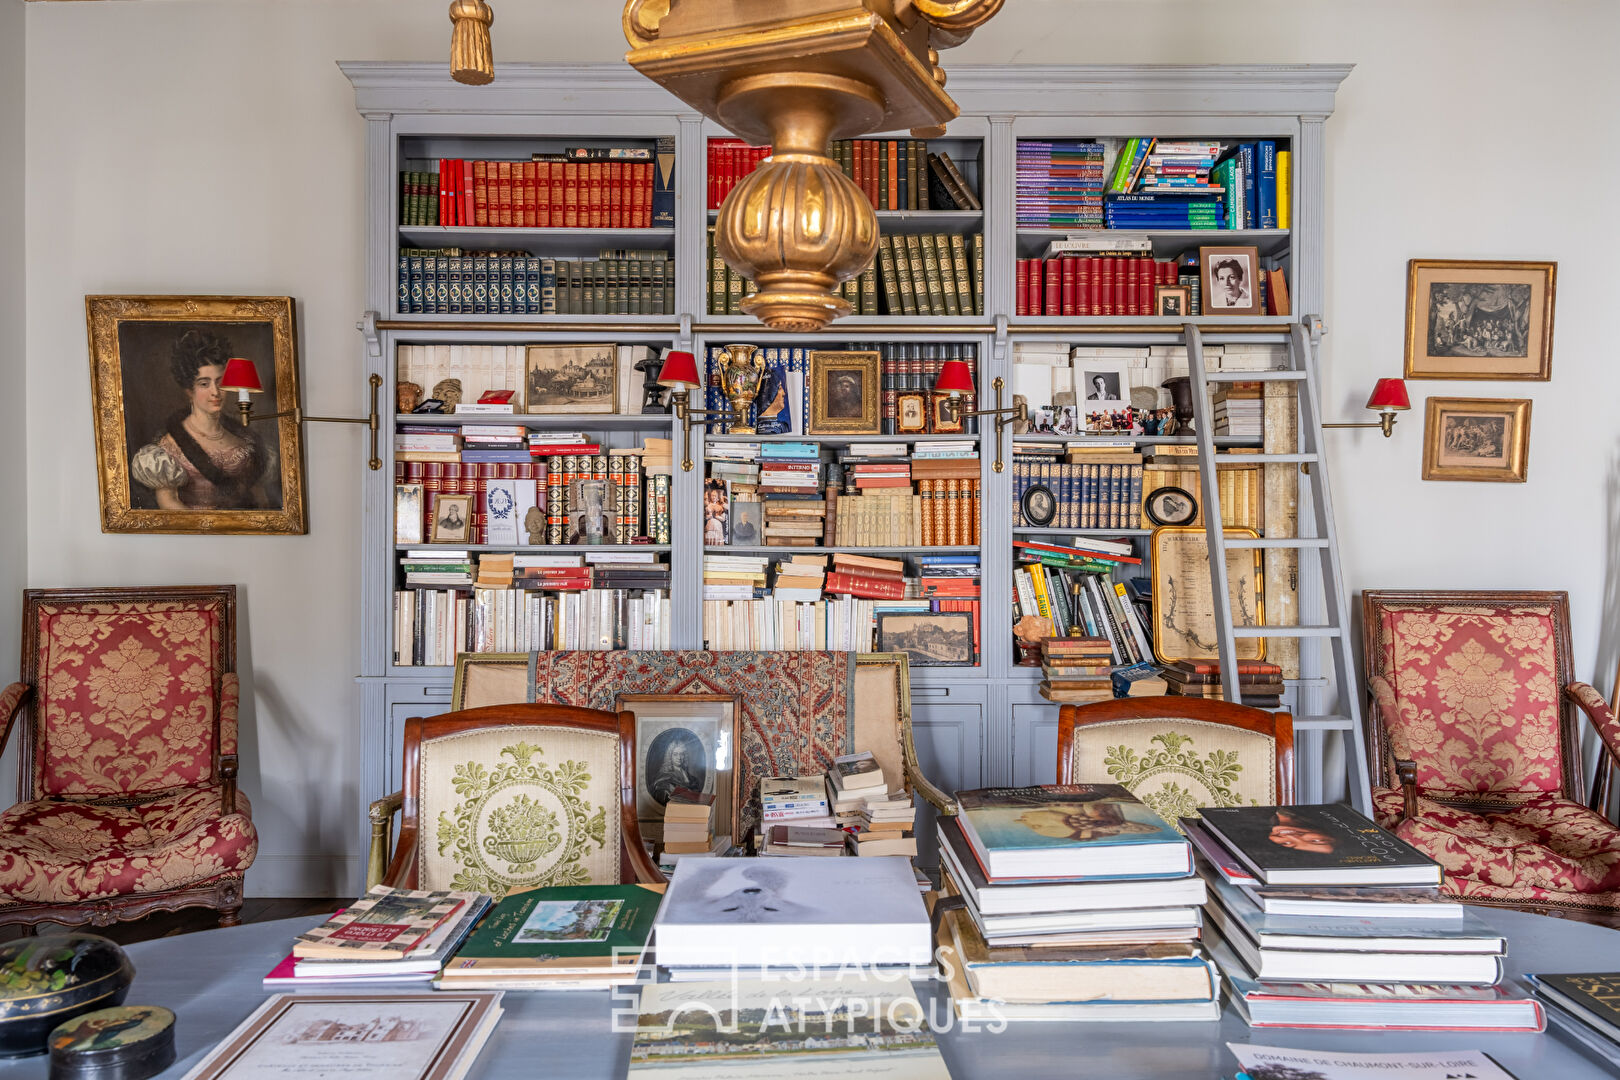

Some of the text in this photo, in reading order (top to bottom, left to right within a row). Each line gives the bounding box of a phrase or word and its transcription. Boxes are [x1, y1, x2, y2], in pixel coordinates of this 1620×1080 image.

[1253, 1052, 1478, 1070] DOMAINE DE CHAUMONT-SUR-LOIRE
